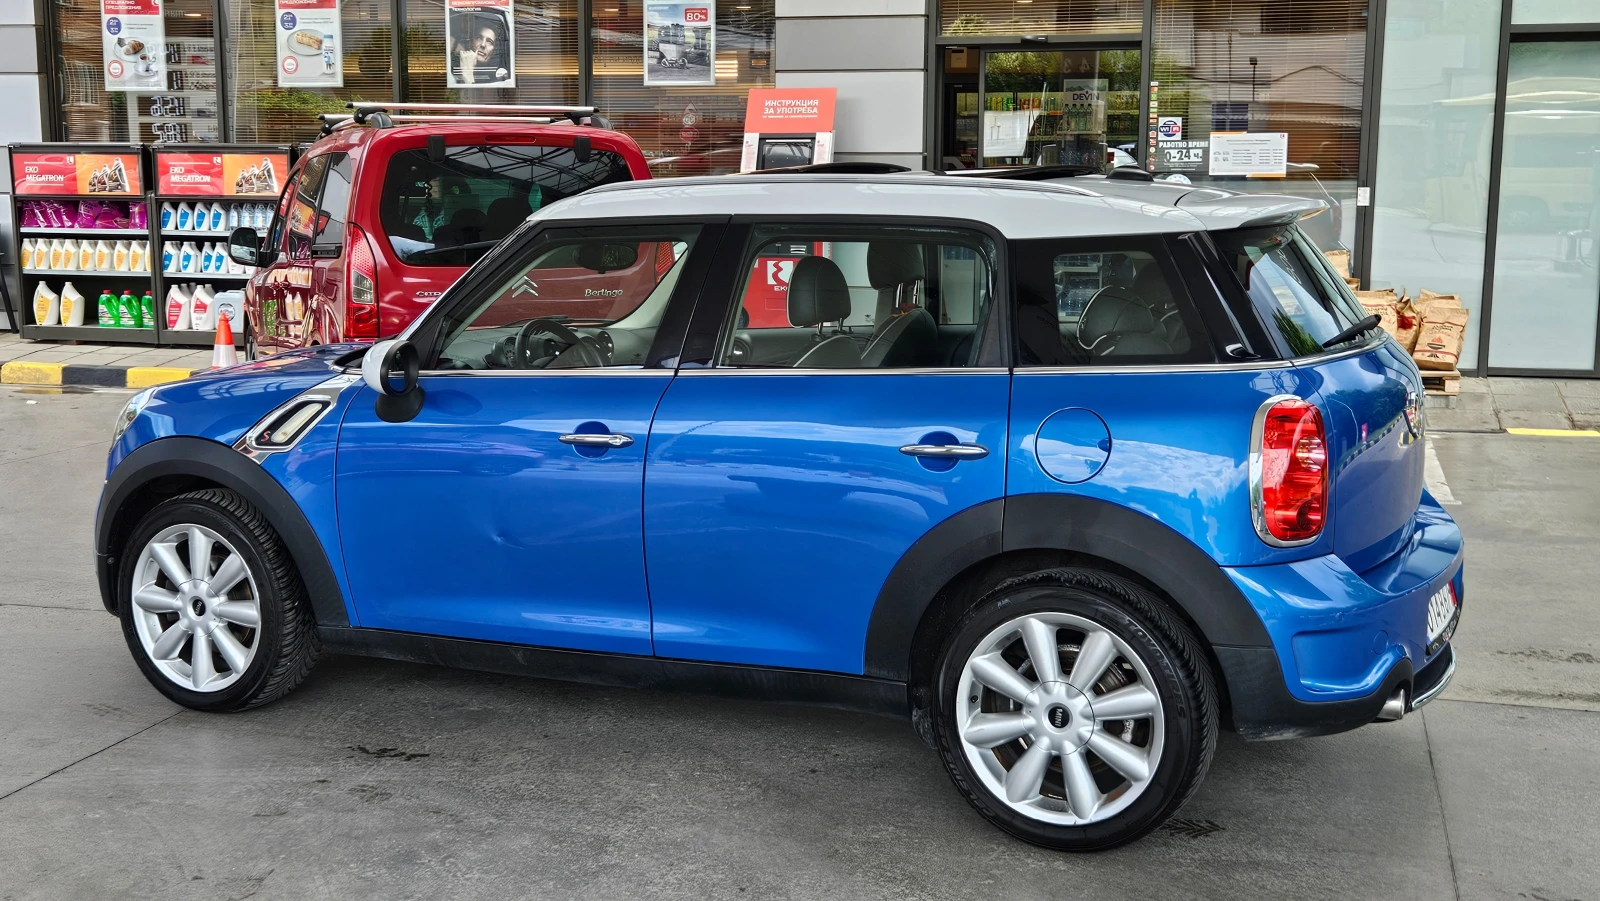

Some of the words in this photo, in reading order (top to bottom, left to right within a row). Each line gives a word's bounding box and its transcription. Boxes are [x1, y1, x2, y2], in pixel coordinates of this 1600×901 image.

[686, 12, 706, 21] 80%
[1072, 93, 1100, 101] DEVIN
[765, 99, 819, 107] ИНСТРУКЦИЯ
[25, 166, 39, 174] EKO
[170, 166, 185, 174] EKO
[25, 174, 64, 182] MEGATRON
[170, 174, 211, 183] MEGATRON
[584, 288, 624, 298] Berlingo
[260, 430, 271, 442] S
[1055, 708, 1063, 727] MINI
